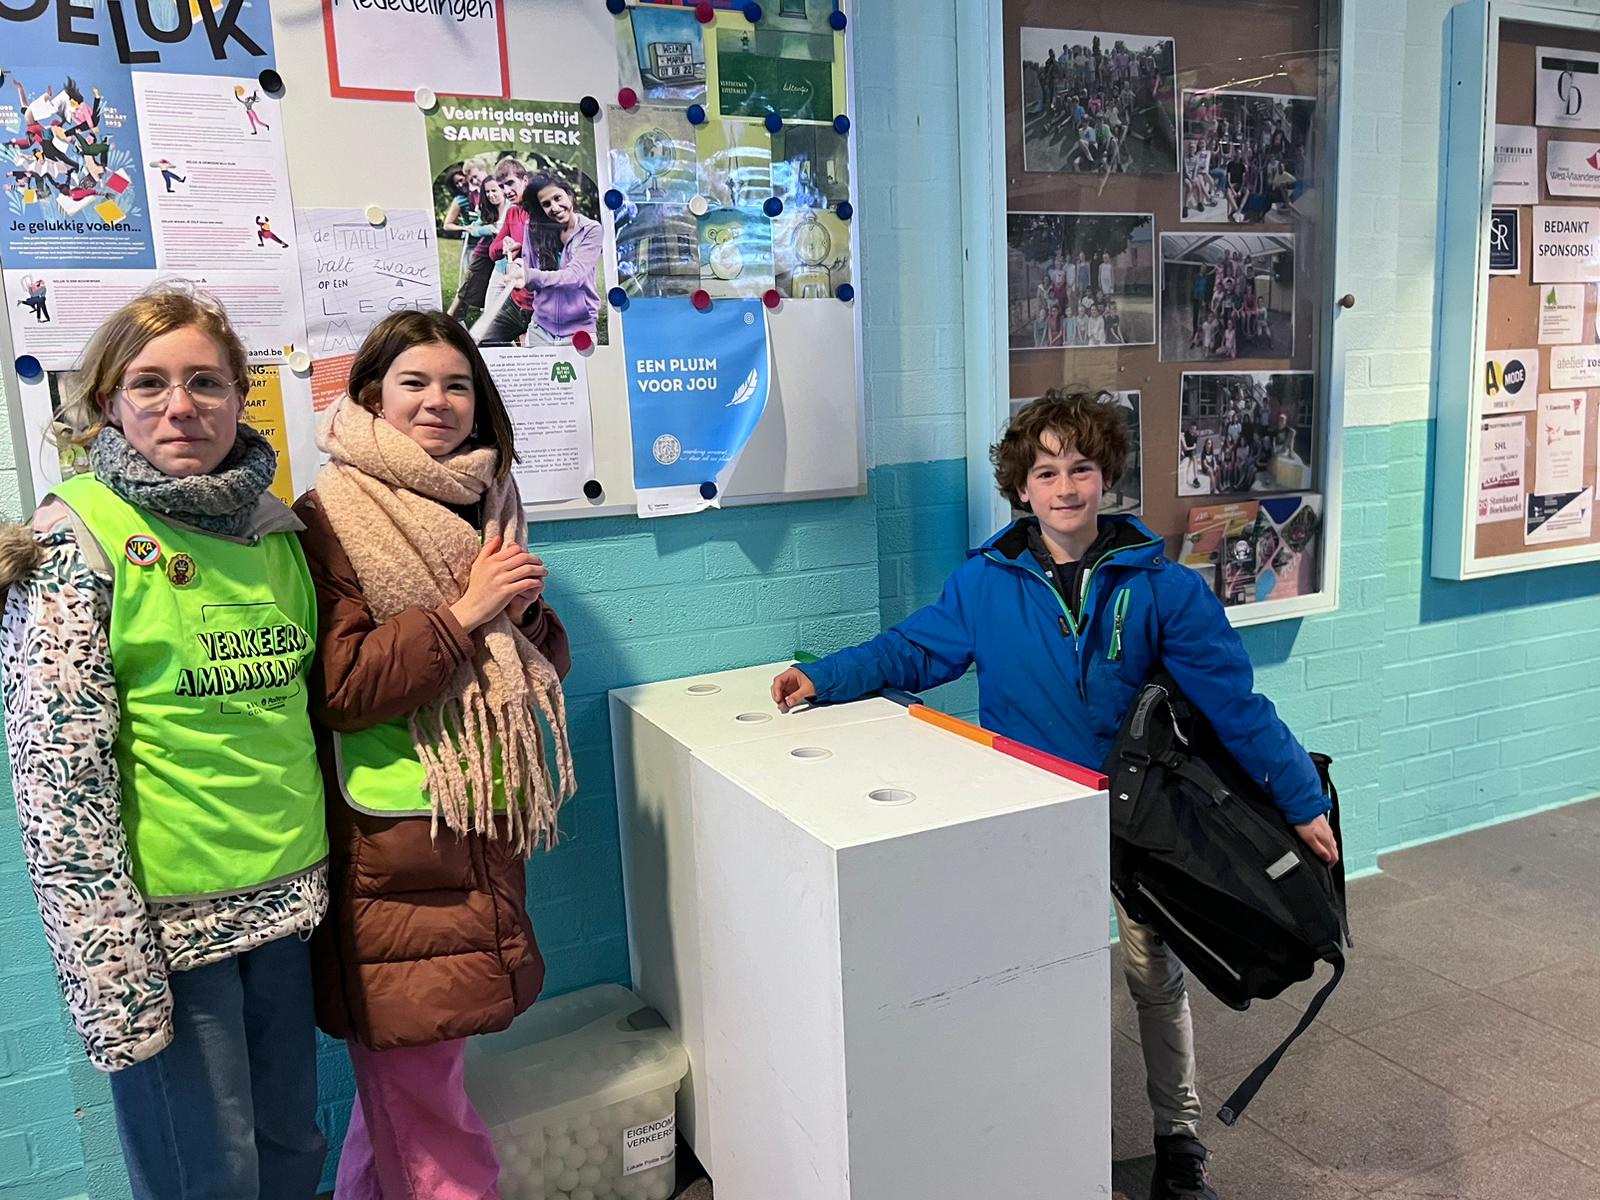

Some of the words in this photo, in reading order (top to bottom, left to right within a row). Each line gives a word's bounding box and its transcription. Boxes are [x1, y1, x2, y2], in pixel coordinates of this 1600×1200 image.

[334, 0, 494, 22] ededelingen
[441, 105, 580, 126] Veertigdagentijd
[443, 125, 515, 143] SAMEN
[519, 128, 581, 146] STERK
[9, 220, 26, 232] Je
[28, 219, 85, 234] gelukkig
[86, 220, 142, 232] voelen...
[1543, 219, 1590, 234] BEDANKT
[313, 228, 330, 243] de
[339, 229, 381, 250] TAFEL
[417, 227, 430, 249] 4
[1538, 243, 1594, 257] SPONSORS!
[317, 255, 355, 274] valt
[373, 258, 430, 279] zwaar
[318, 280, 330, 290] OP
[333, 279, 349, 289] EEN
[248, 348, 283, 357] aand.be
[636, 358, 666, 373] EEN
[672, 357, 718, 372] PLUIM
[1556, 356, 1585, 370] atelier
[249, 379, 268, 388] ART
[637, 379, 683, 393] VOOR
[686, 377, 718, 392] JOU
[1504, 369, 1524, 386] MODE
[245, 399, 267, 408] AART
[259, 428, 276, 437] ART
[131, 541, 153, 556] VKA
